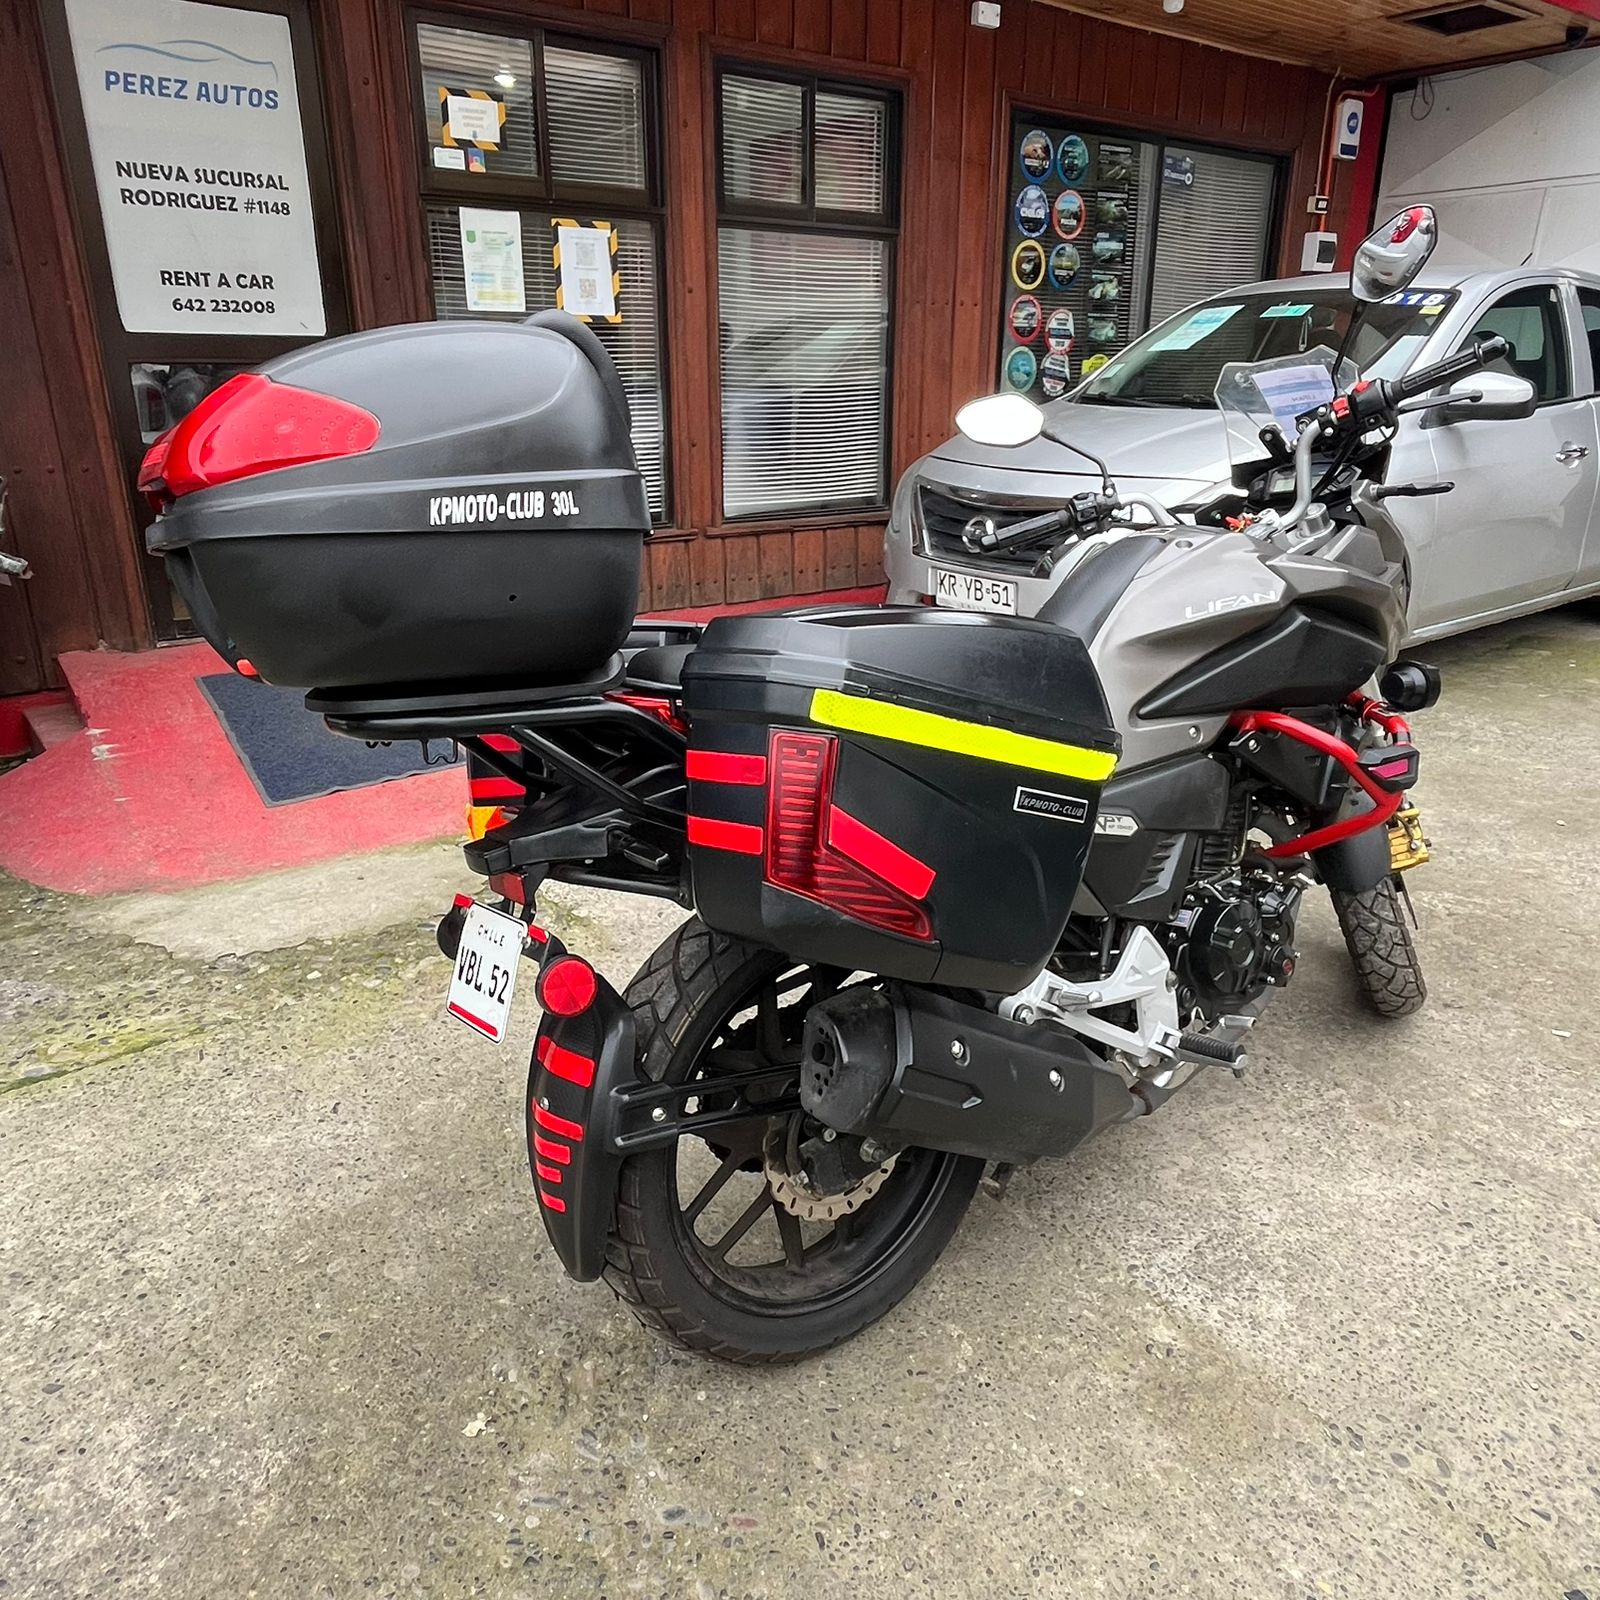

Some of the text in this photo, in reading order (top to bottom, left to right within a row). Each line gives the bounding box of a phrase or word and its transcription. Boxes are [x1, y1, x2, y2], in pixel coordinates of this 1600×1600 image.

[105, 70, 279, 110] PEREZ AUTOS
[115, 160, 290, 191] NUEVA SUCURSAL
[120, 188, 291, 216] RODRIGUEZ #1148
[159, 270, 274, 290] RENT A CAR
[171, 298, 276, 314] 642 232008
[429, 490, 580, 526] KPMOTO-CLUB 30L
[1185, 590, 1276, 619] LIFAN
[477, 924, 506, 947] CHILE
